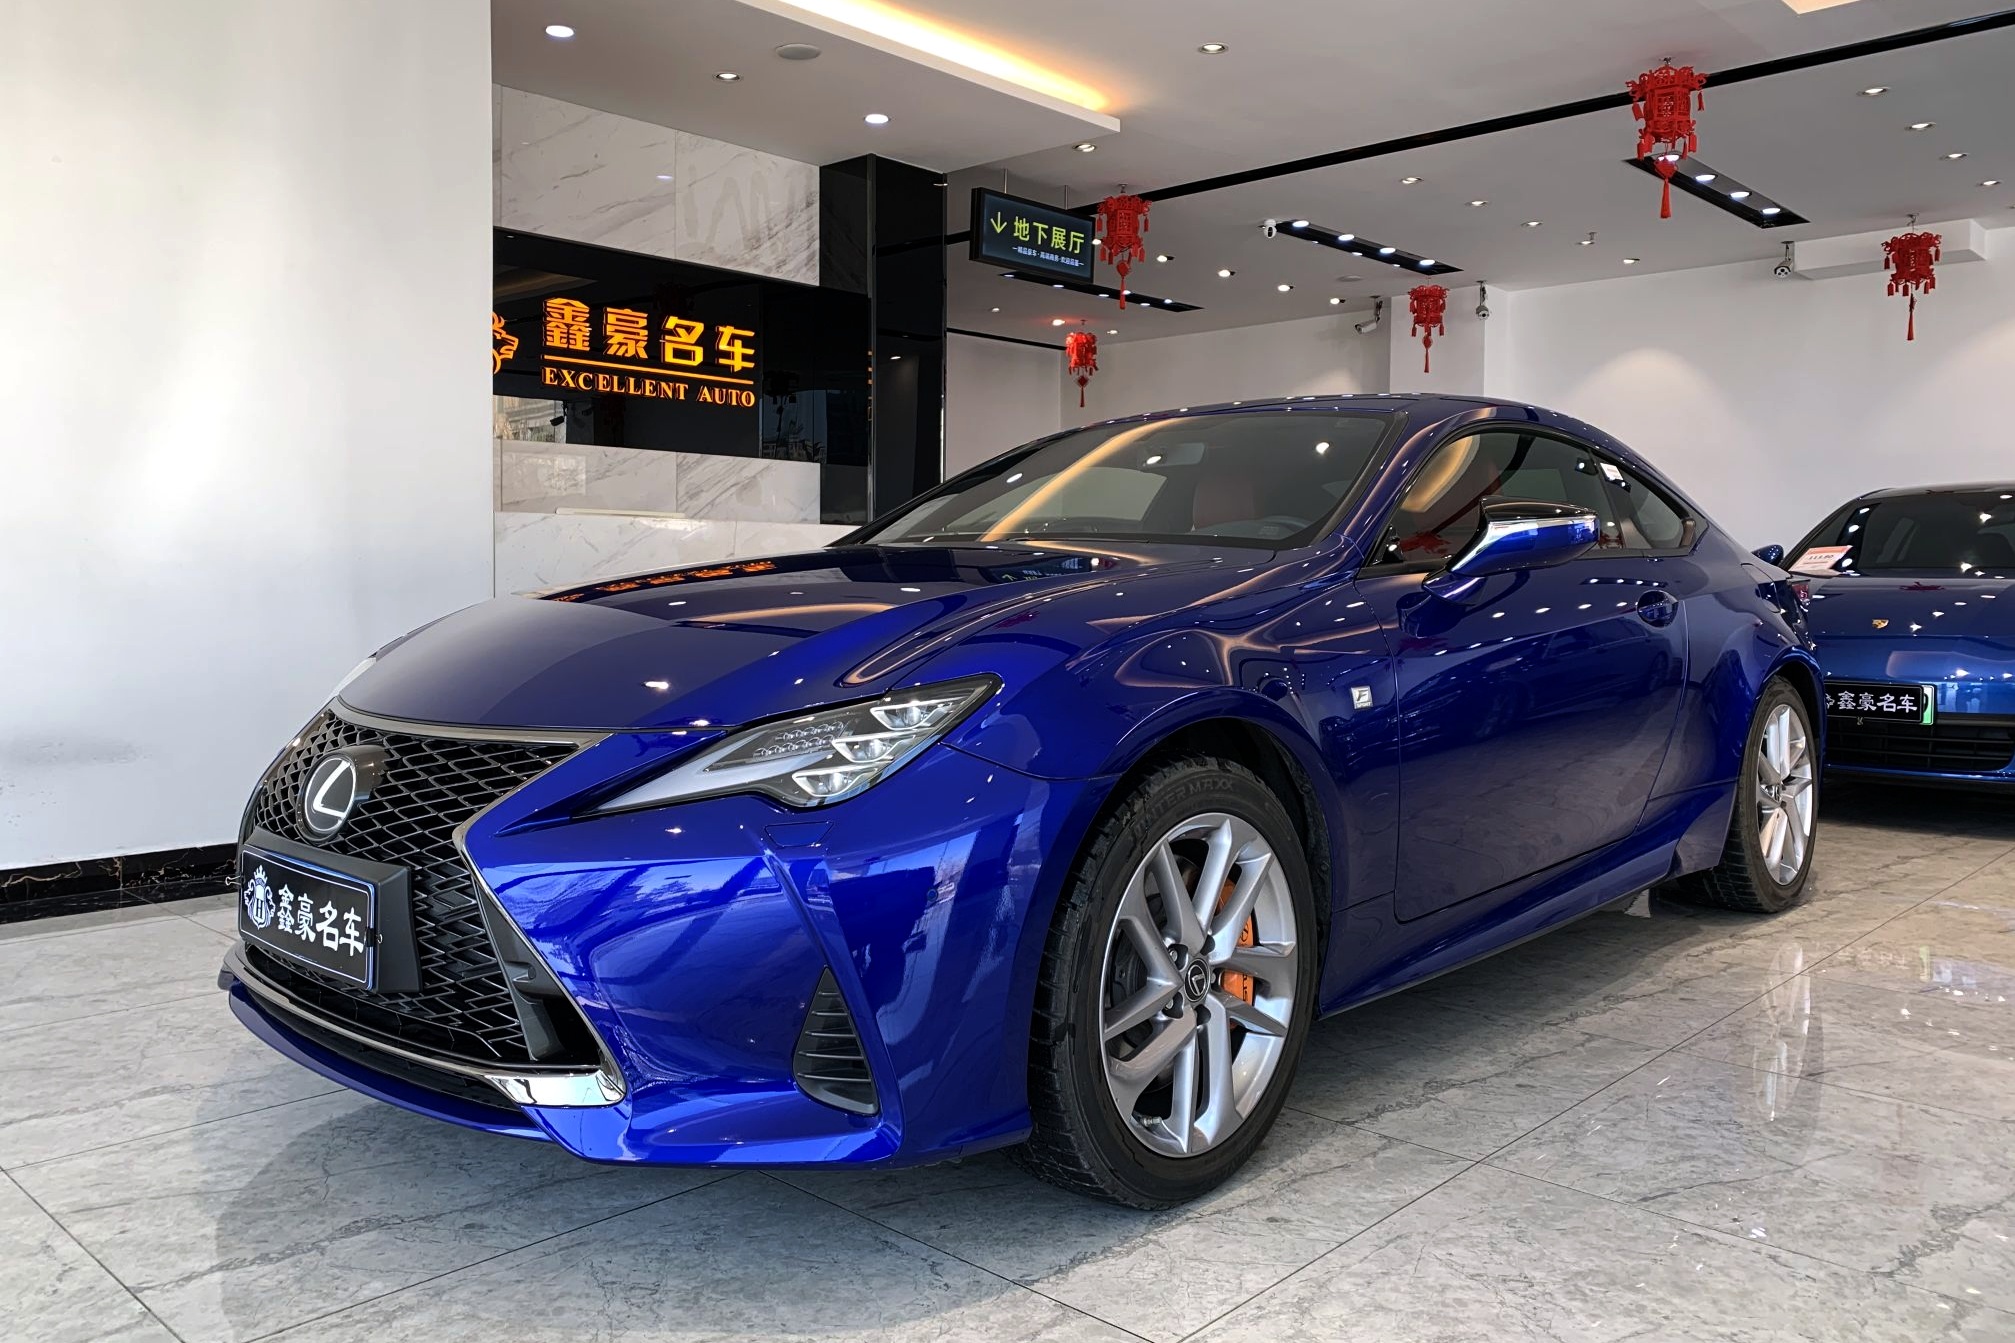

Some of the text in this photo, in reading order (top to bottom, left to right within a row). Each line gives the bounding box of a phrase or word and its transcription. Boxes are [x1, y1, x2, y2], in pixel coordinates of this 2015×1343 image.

[1013, 216, 1085, 254] 地下展厅
[544, 297, 755, 372] 鑫豪名车
[543, 367, 755, 407] EXCELLENT AUTO
[1837, 690, 1918, 714] 鑫豪名车
[1189, 778, 1233, 794] MAXX
[276, 883, 365, 957] 鑫豪名车
